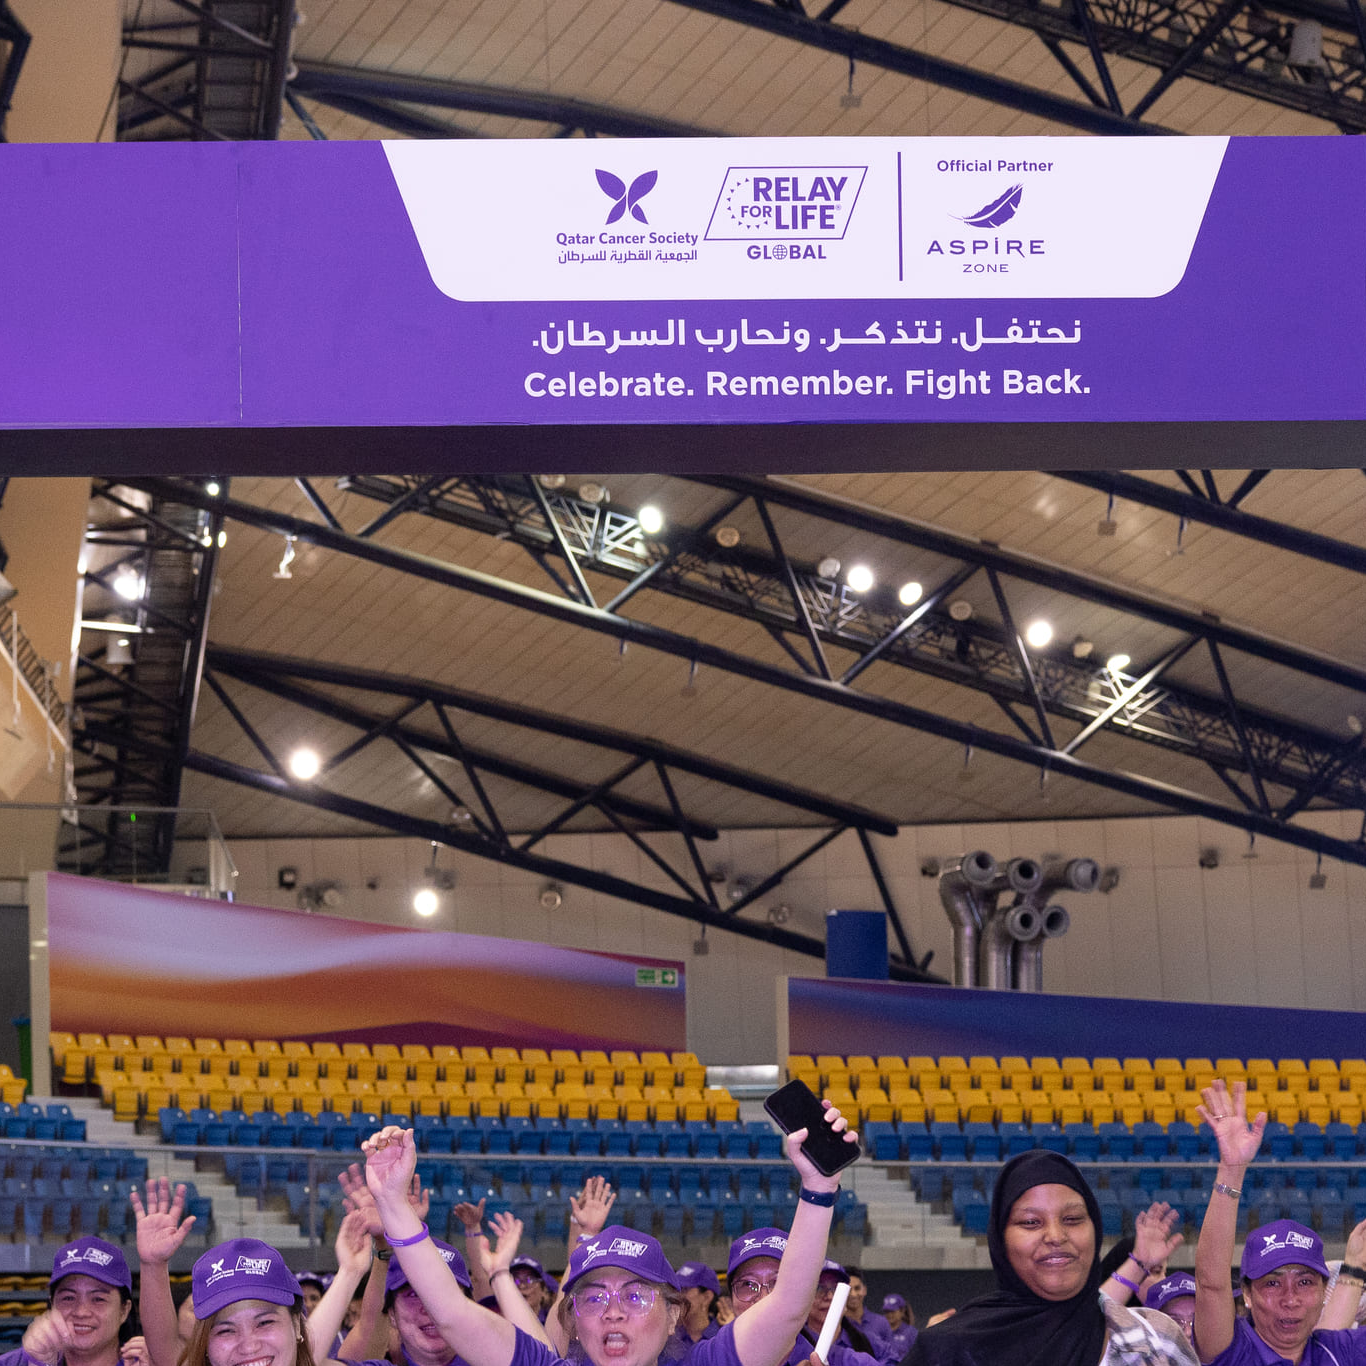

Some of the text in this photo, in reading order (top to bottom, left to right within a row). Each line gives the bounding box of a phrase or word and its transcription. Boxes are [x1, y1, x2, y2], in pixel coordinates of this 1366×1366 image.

[937, 160, 1053, 172] Official Partner
[754, 177, 847, 201] RELAY
[741, 205, 835, 229] FOR LIFE
[556, 232, 698, 246] Qatar Cancer Society
[558, 250, 697, 264] الجمعية القطرية للسرطان
[962, 263, 1009, 273] ZONE
[533, 320, 685, 354] السرطان.
[695, 319, 810, 355] ونحارب
[525, 369, 1090, 399] Celebrate. Remember. Fight Back.
